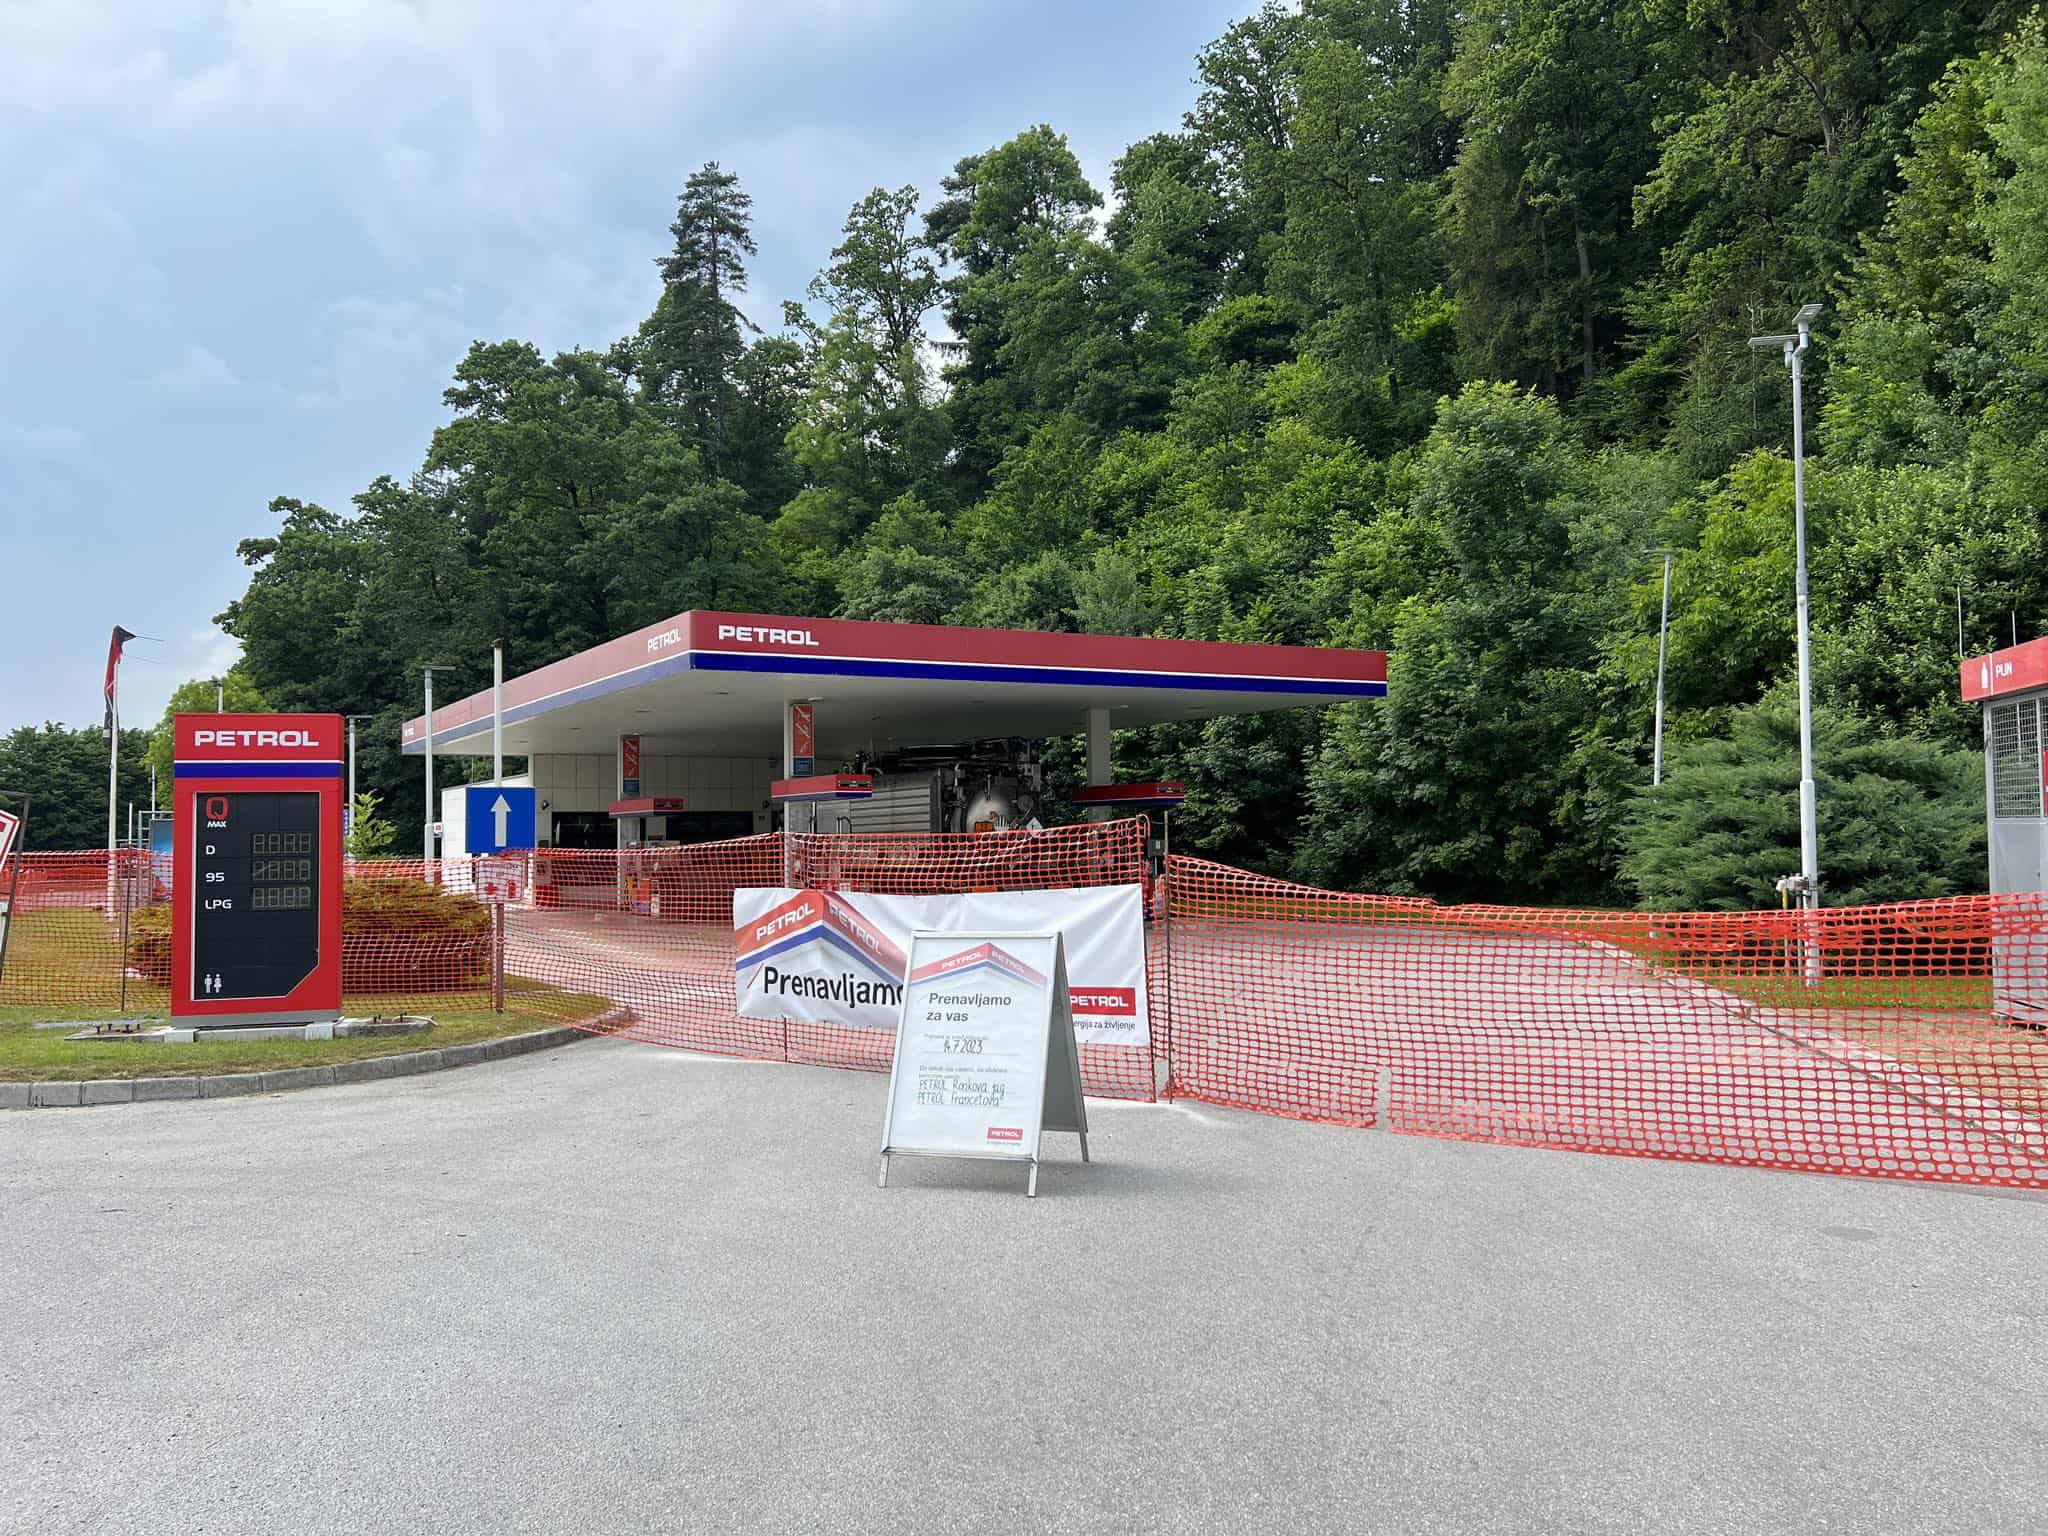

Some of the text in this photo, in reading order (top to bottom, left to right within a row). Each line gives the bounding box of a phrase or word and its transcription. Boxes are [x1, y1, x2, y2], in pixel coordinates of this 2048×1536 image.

[647, 628, 681, 652] PETROL
[718, 624, 819, 646] PETROL
[194, 731, 319, 747] PETROL
[206, 797, 229, 820] Q
[205, 845, 216, 856] D
[205, 872, 225, 883] 95
[205, 899, 232, 910] LPG
[755, 902, 816, 942] PETROL
[828, 900, 882, 956] PETROL
[941, 951, 985, 970] PETROL
[929, 992, 1012, 1008] Prenavljamo
[1070, 995, 1129, 1008] PETROL
[926, 1012, 969, 1022] za vas
